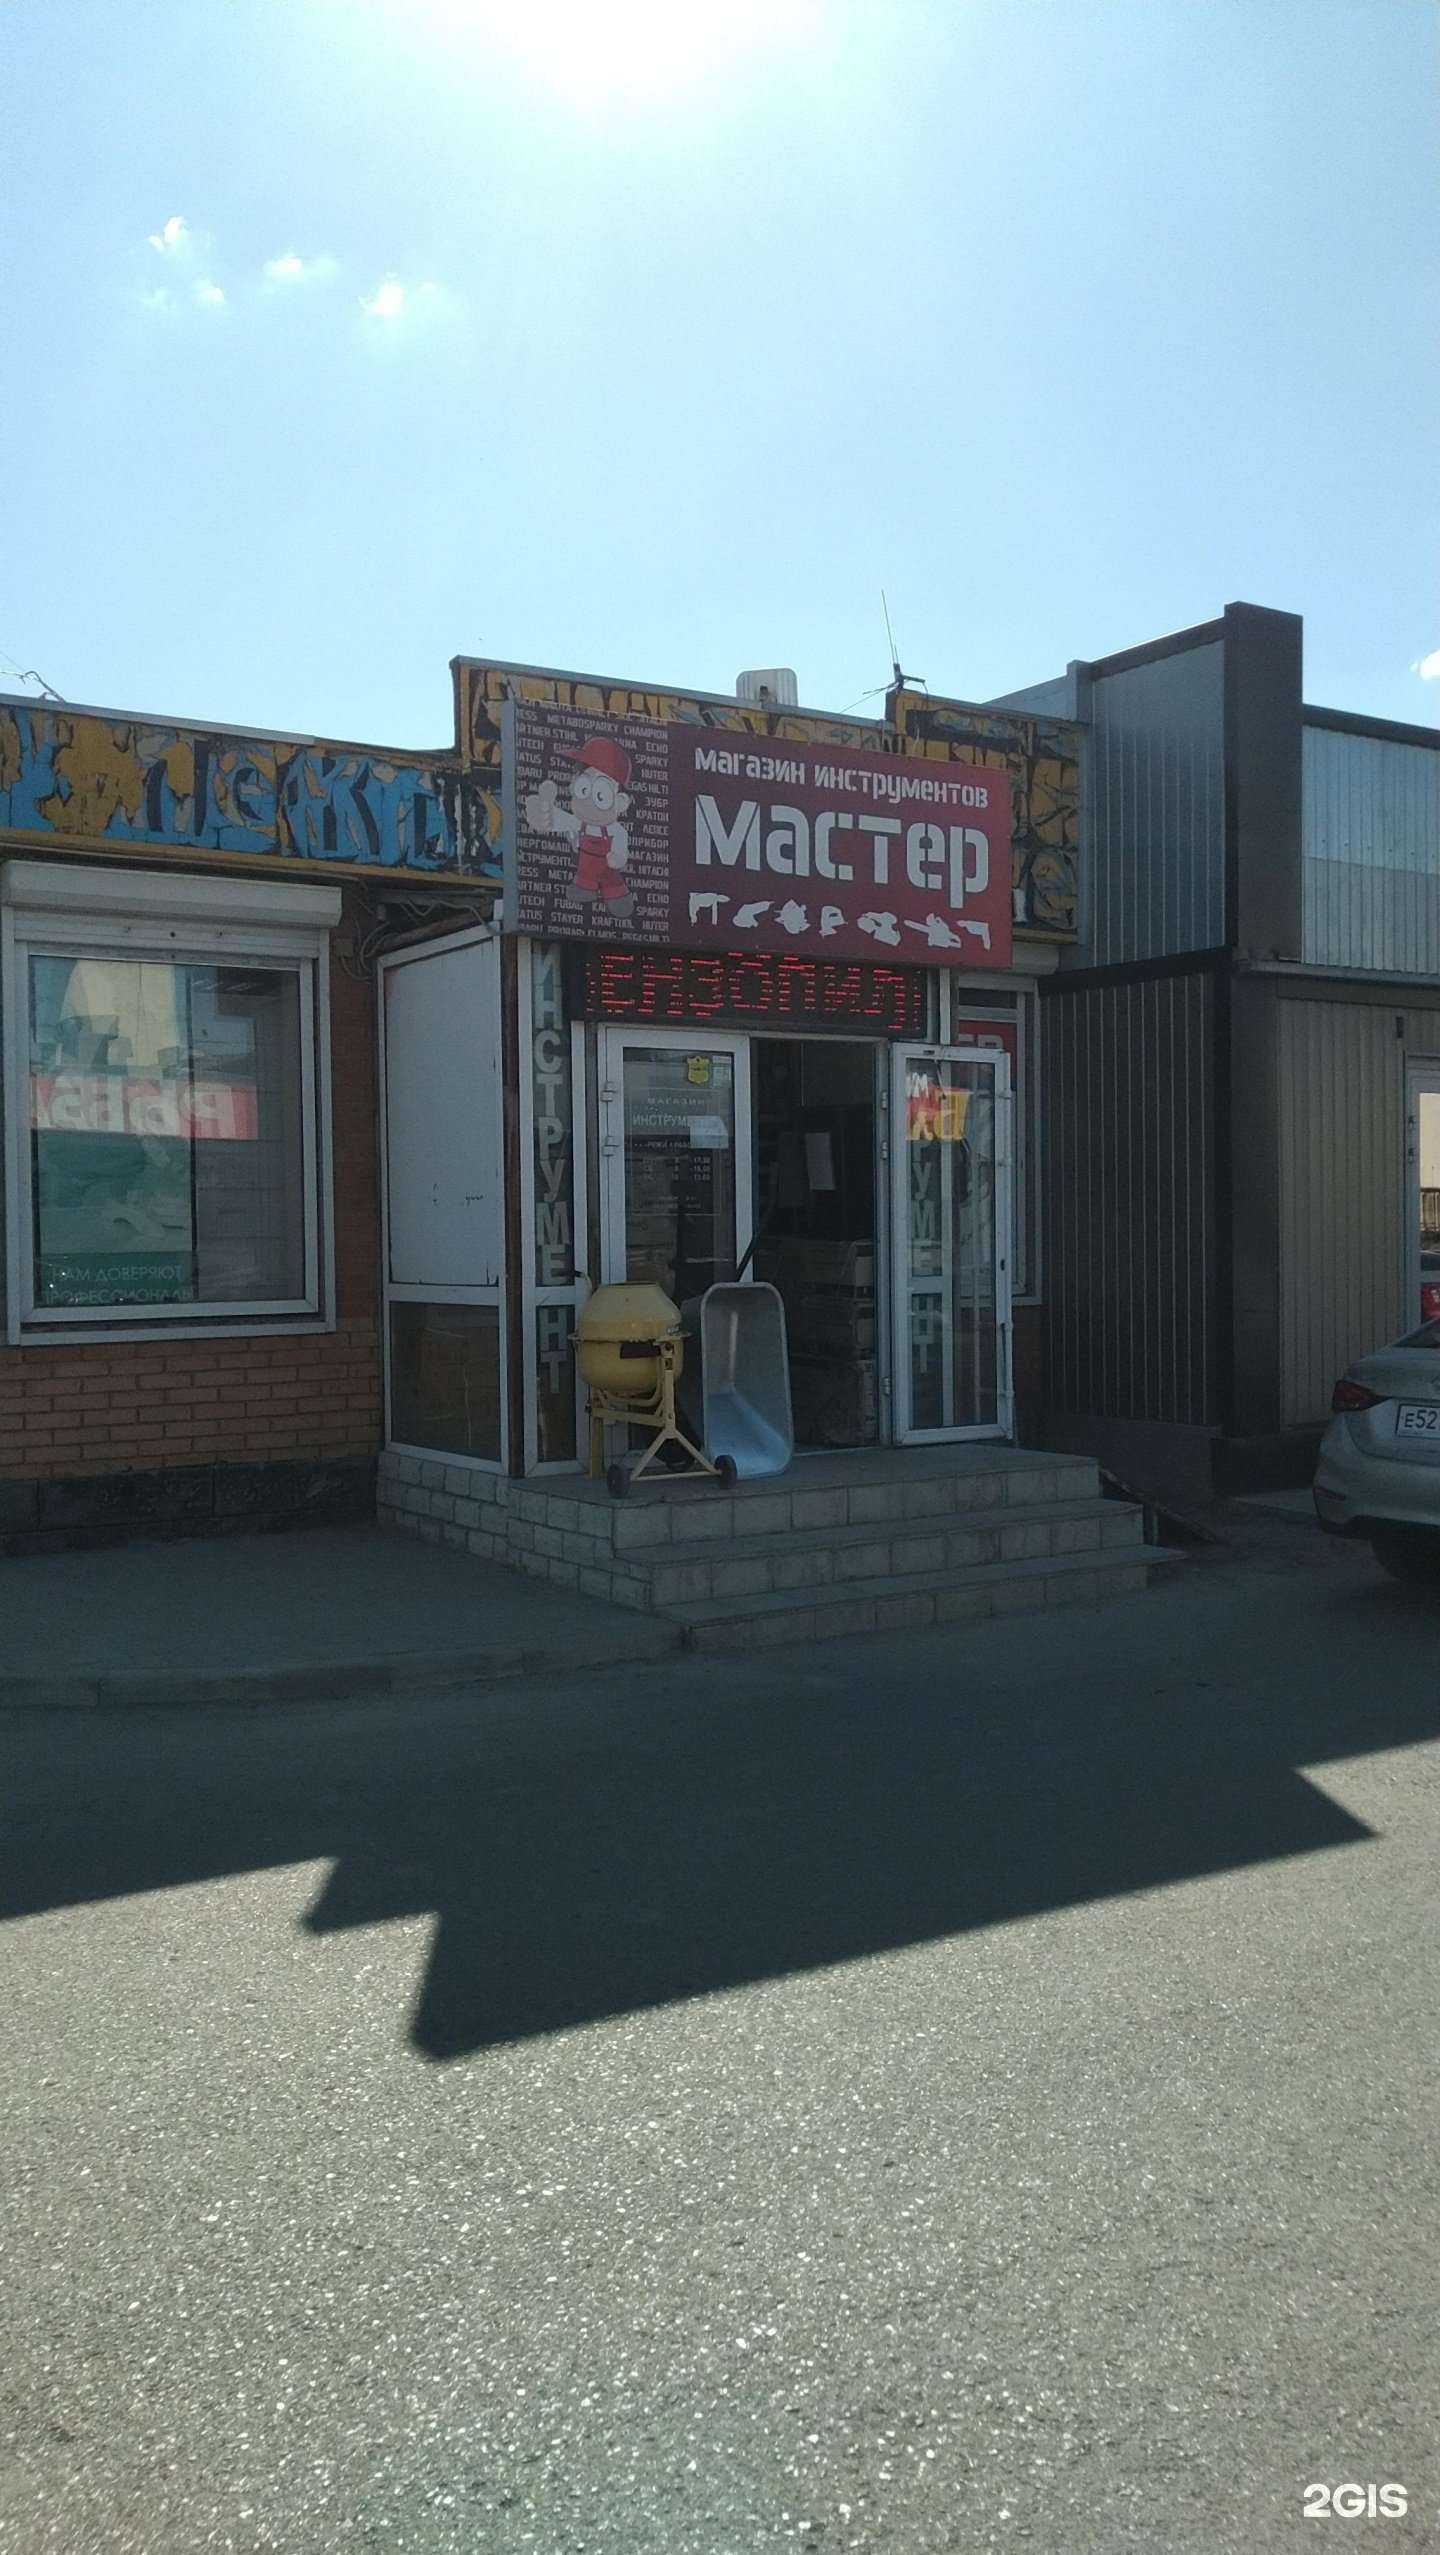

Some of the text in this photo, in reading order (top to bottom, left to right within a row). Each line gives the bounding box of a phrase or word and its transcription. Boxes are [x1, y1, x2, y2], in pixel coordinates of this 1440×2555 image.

[516, 709, 538, 721] ESS
[624, 726, 668, 740] CHAMPION
[646, 741, 668, 754] ECHO
[516, 752, 542, 765] ATUS
[635, 753, 669, 768] SPARKY
[815, 764, 989, 809] инструментов
[645, 797, 668, 809] ЗУБР
[647, 892, 669, 904] ECHO
[518, 910, 543, 921] ATUS
[551, 911, 583, 925] STAYER
[636, 905, 670, 919] SPARKY
[586, 951, 921, 1029] ЕНЗОПИЛ
[632, 1113, 690, 1129] ИНСТРУМ
[532, 941, 573, 1394] ИНСТРУМЕНТ
[95, 1264, 183, 1282] ДОВЕРЯЮТ
